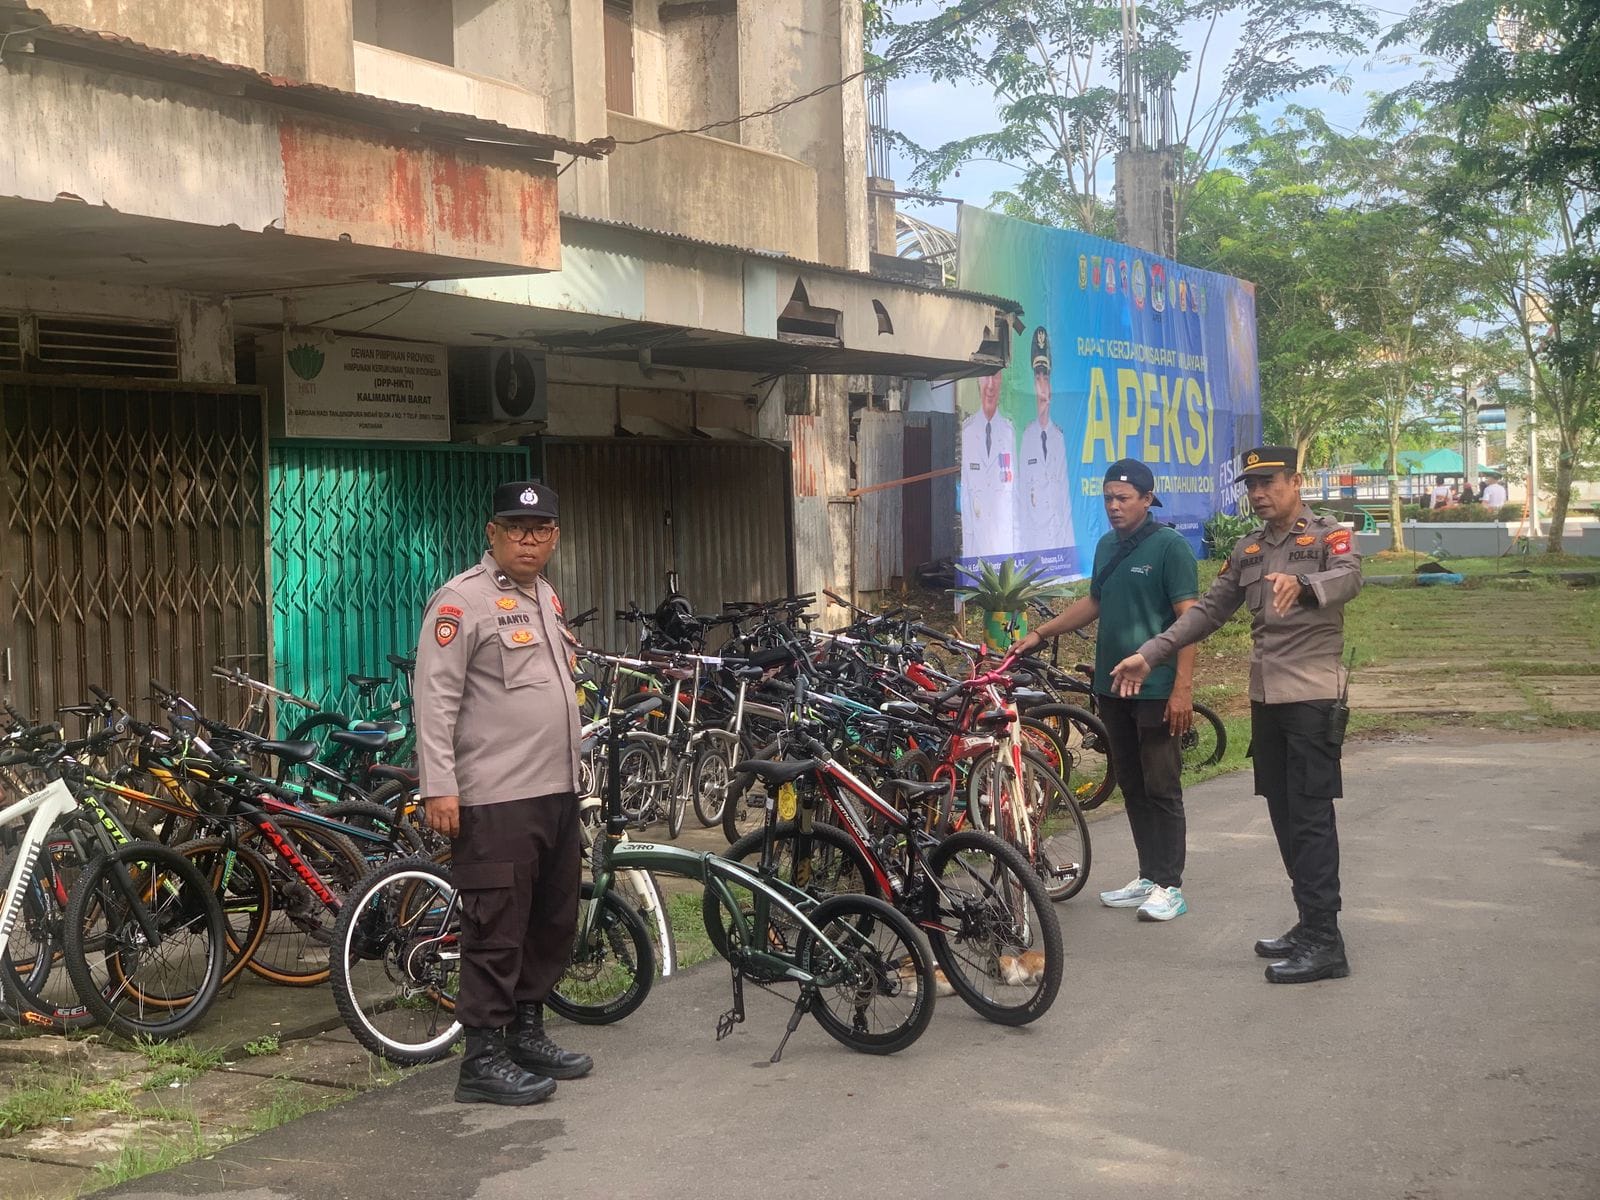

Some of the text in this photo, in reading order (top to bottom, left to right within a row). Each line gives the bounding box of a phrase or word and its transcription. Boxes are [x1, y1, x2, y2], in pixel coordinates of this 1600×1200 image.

[1077, 336, 1105, 358] RAPAT
[351, 348, 375, 360] DEWAN
[406, 351, 435, 364] PROVINSI
[374, 378, 414, 390] (DPP-HKTI)
[357, 392, 432, 404] KALIMANTAN BARAT
[1081, 367, 1214, 466] APEKSI
[1288, 549, 1319, 561] POLRI
[259, 820, 337, 905] FASTRION
